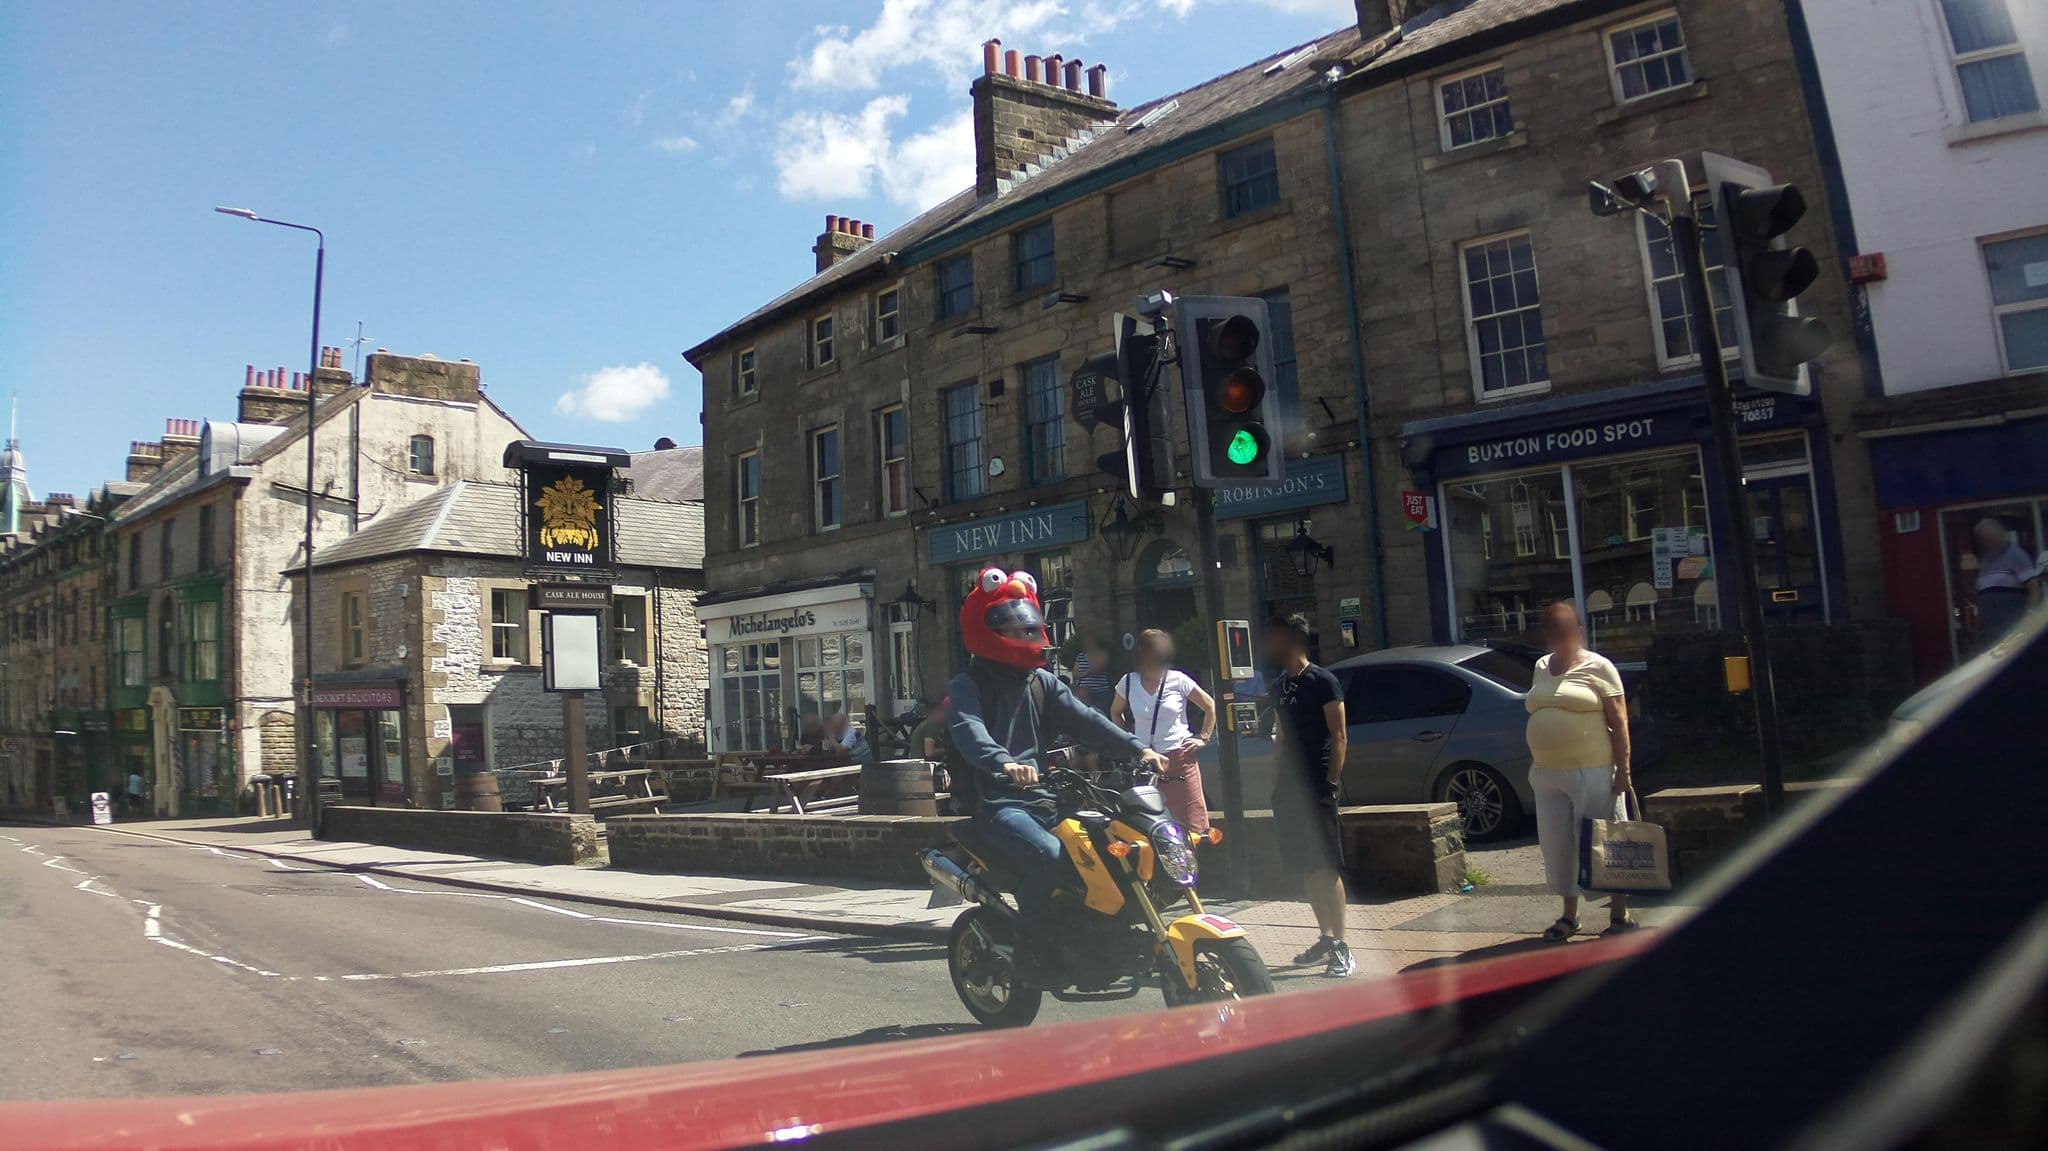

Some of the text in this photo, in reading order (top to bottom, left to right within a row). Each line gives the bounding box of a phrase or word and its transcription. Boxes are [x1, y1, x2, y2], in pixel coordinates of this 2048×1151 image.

[1468, 419, 1654, 464] BUXTON FOOD SPOT
[1407, 495, 1423, 506] JUST
[1411, 505, 1424, 516] EAT
[955, 514, 1053, 553] NEW INN
[546, 551, 593, 564] NEW INN
[545, 591, 606, 600] CASK ALE HOUSE
[729, 609, 816, 638] Michelangelo's
[347, 692, 392, 704] SOLICITORS
[1201, 916, 1234, 931] L
